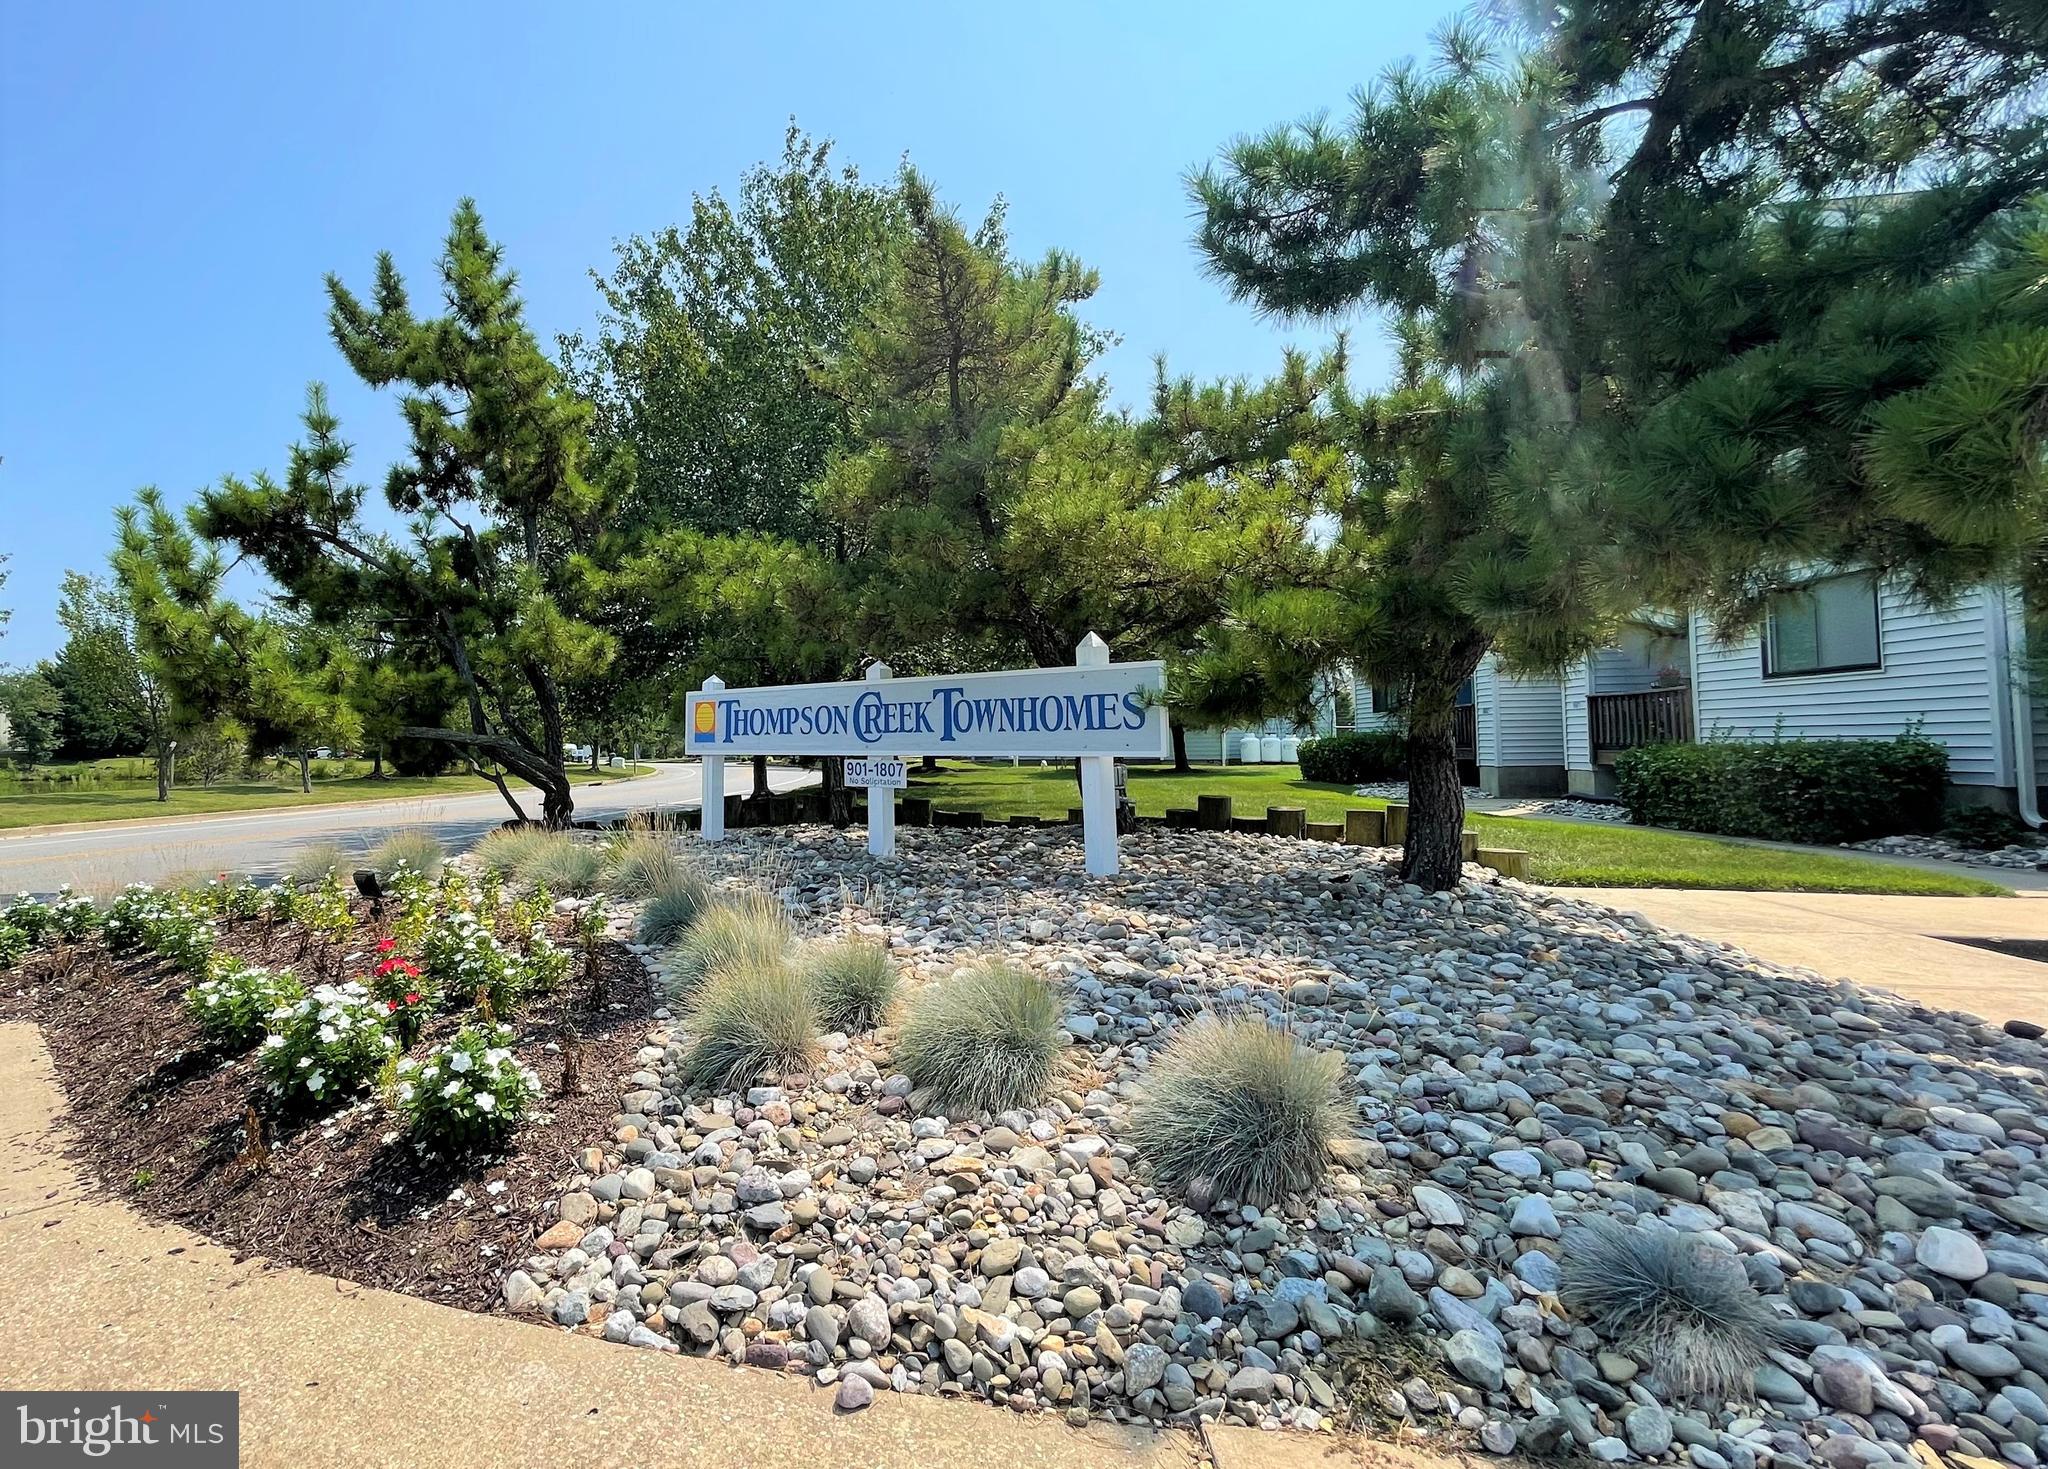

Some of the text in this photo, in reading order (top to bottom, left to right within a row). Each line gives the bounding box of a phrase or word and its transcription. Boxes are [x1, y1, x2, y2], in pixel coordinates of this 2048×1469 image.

[718, 687, 1146, 743] THOMPSON CREEK TOWNHOMES
[847, 762, 903, 776] 901-1807
[861, 777, 901, 786] Solicitation
